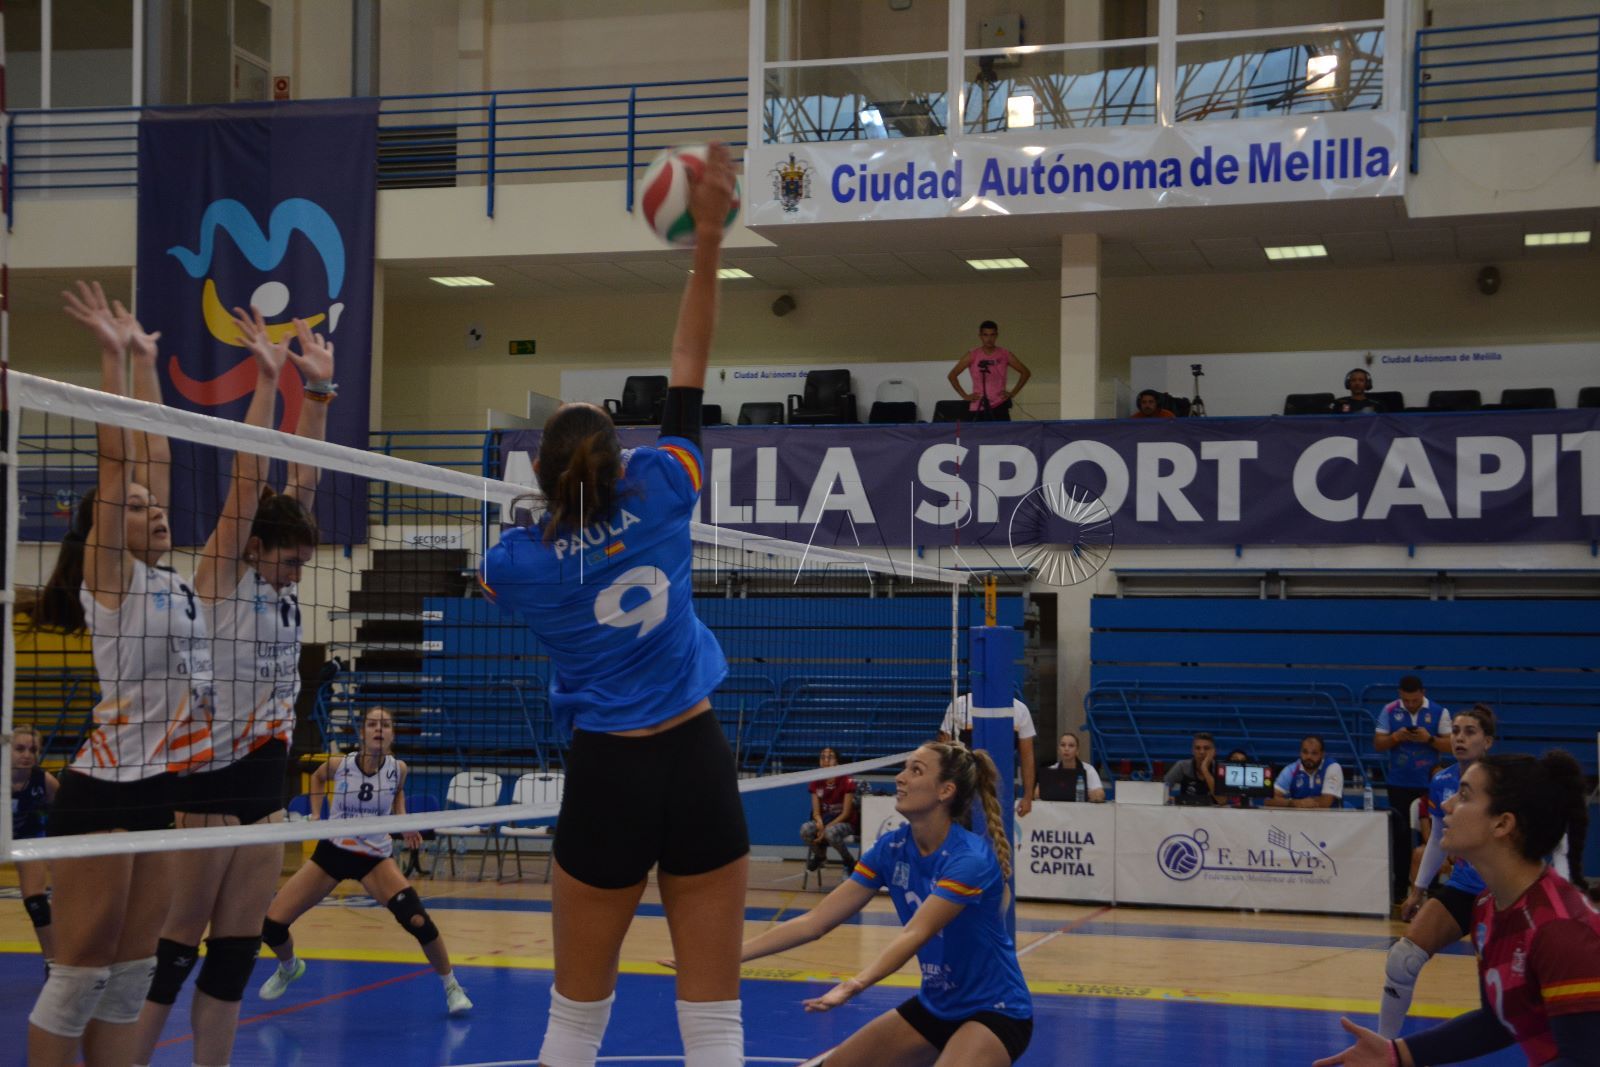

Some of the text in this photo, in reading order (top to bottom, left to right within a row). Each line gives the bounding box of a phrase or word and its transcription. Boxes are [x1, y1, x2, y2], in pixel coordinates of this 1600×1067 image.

[831, 137, 1392, 204] Ciudad Autónoma de Melilla
[913, 439, 1258, 526] SPORT
[413, 535, 448, 544] SECTOR
[553, 508, 641, 560] PAULA
[179, 583, 197, 621] 3
[594, 565, 671, 638] 9
[1231, 770, 1258, 784] 7 5
[358, 782, 374, 802] 8
[1030, 829, 1096, 846] MELILLA
[1030, 845, 1083, 861] SPORT
[1217, 847, 1233, 866] F.
[1030, 860, 1095, 877] CAPITAL
